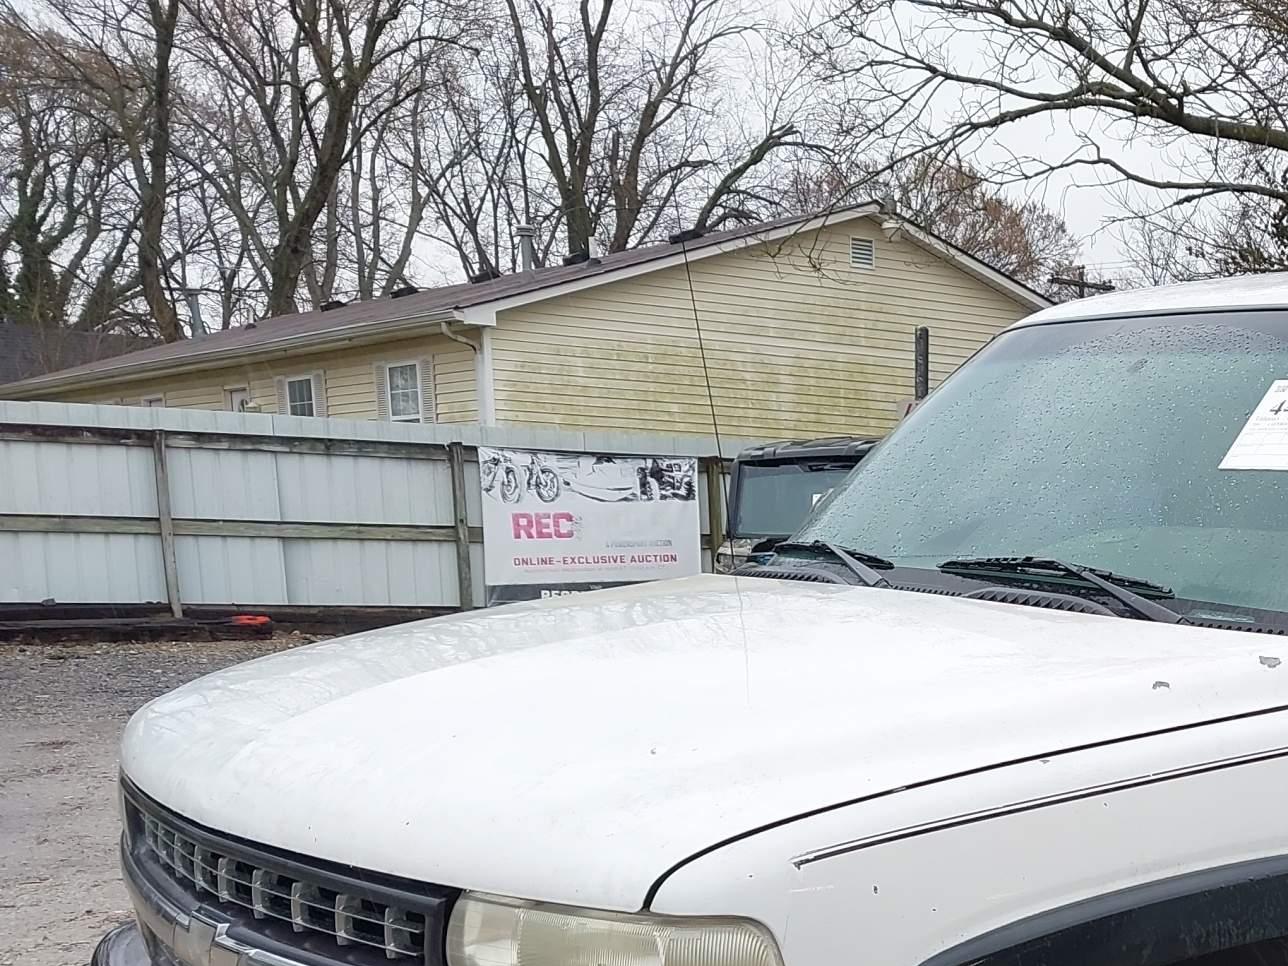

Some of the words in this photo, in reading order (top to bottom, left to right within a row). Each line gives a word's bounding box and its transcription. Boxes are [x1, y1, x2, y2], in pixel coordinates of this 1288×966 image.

[511, 512, 574, 540] REC
[513, 554, 626, 567] ONLINE-EXCLUSIVE
[630, 553, 678, 564] AUCTION
